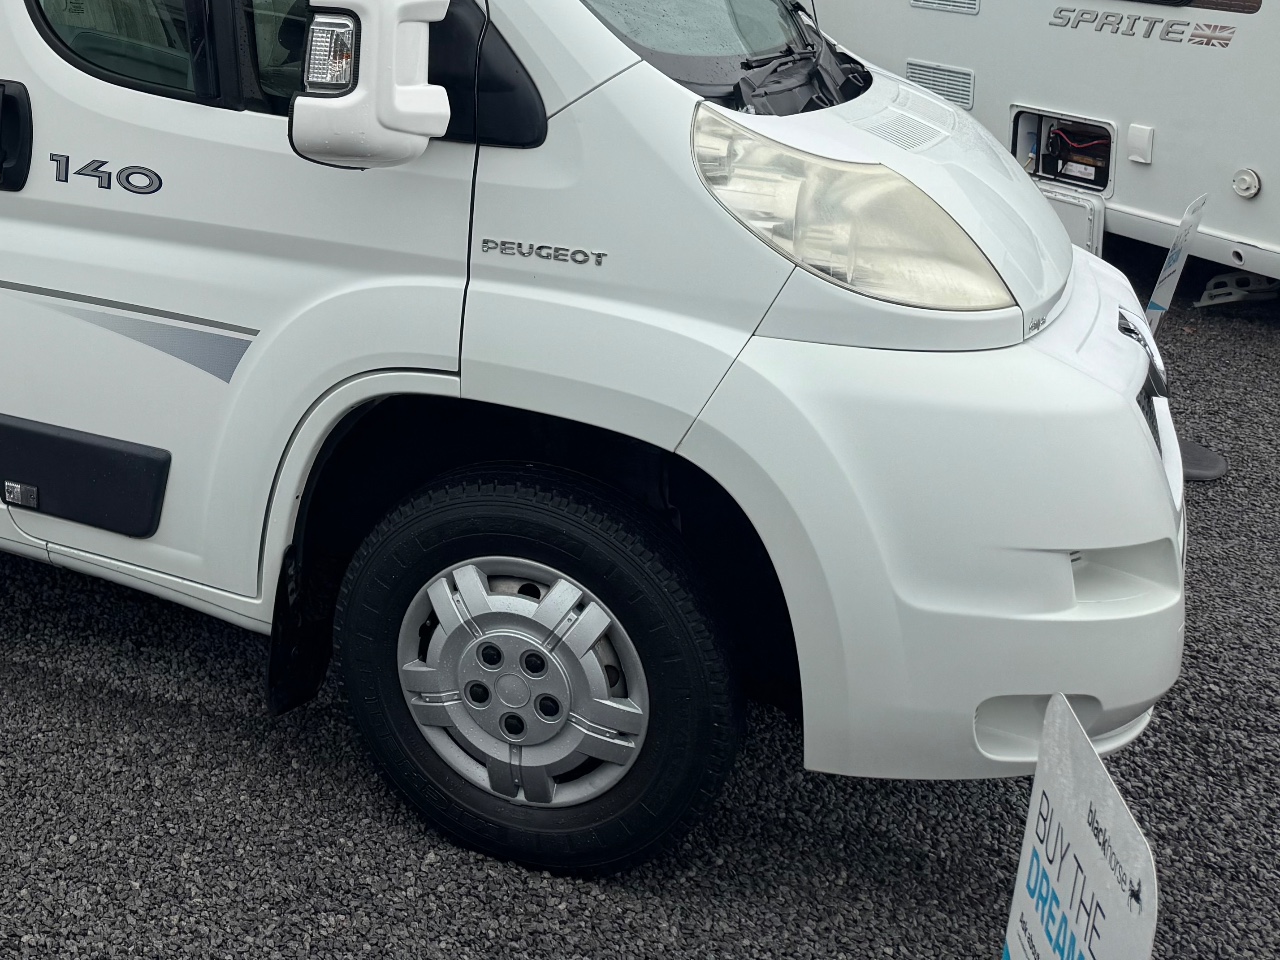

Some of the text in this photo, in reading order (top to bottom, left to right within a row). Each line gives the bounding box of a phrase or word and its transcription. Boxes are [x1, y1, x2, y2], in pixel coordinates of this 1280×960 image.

[1049, 6, 1191, 43] SPRITE
[49, 152, 163, 195] 140
[481, 238, 608, 267] PEUGEOT
[1035, 789, 1106, 960] BUY THE
